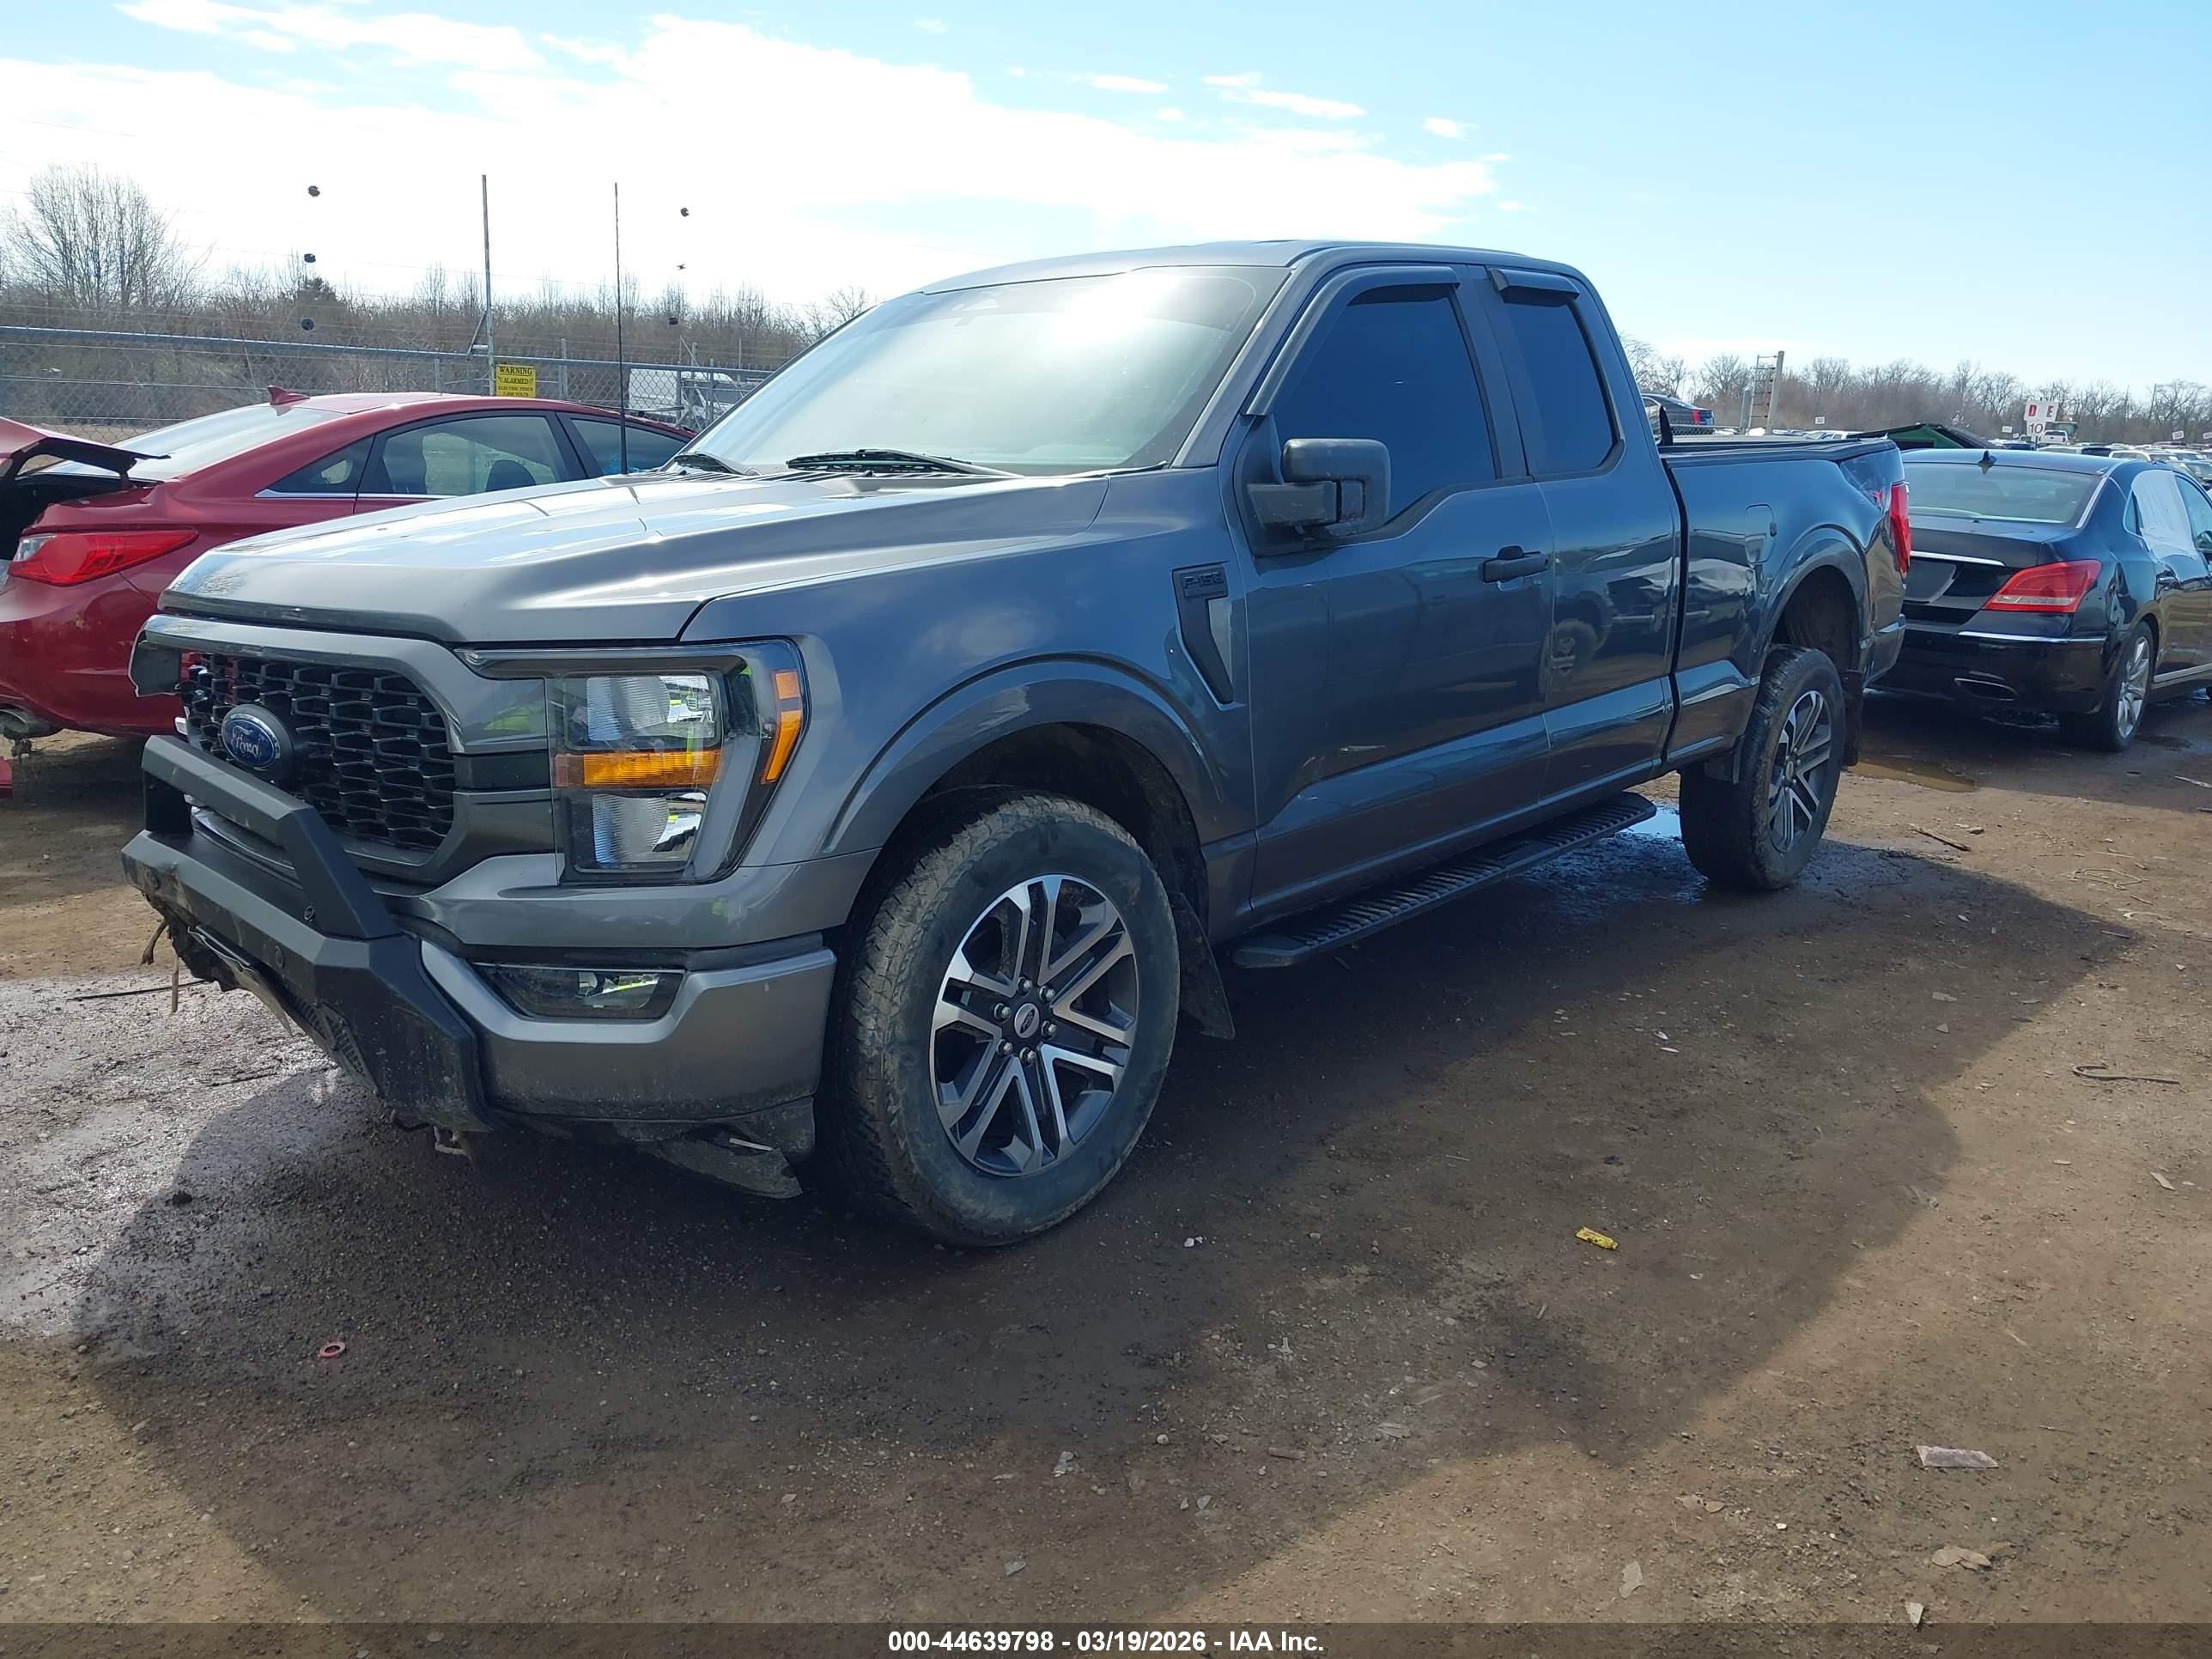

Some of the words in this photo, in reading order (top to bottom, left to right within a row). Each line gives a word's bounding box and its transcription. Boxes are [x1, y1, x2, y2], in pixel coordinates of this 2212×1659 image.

[499, 366, 532, 374] WARNING
[2028, 404, 2037, 416] D
[2046, 405, 2054, 417] E
[2029, 423, 2044, 434] 10
[231, 725, 262, 757] Ford
